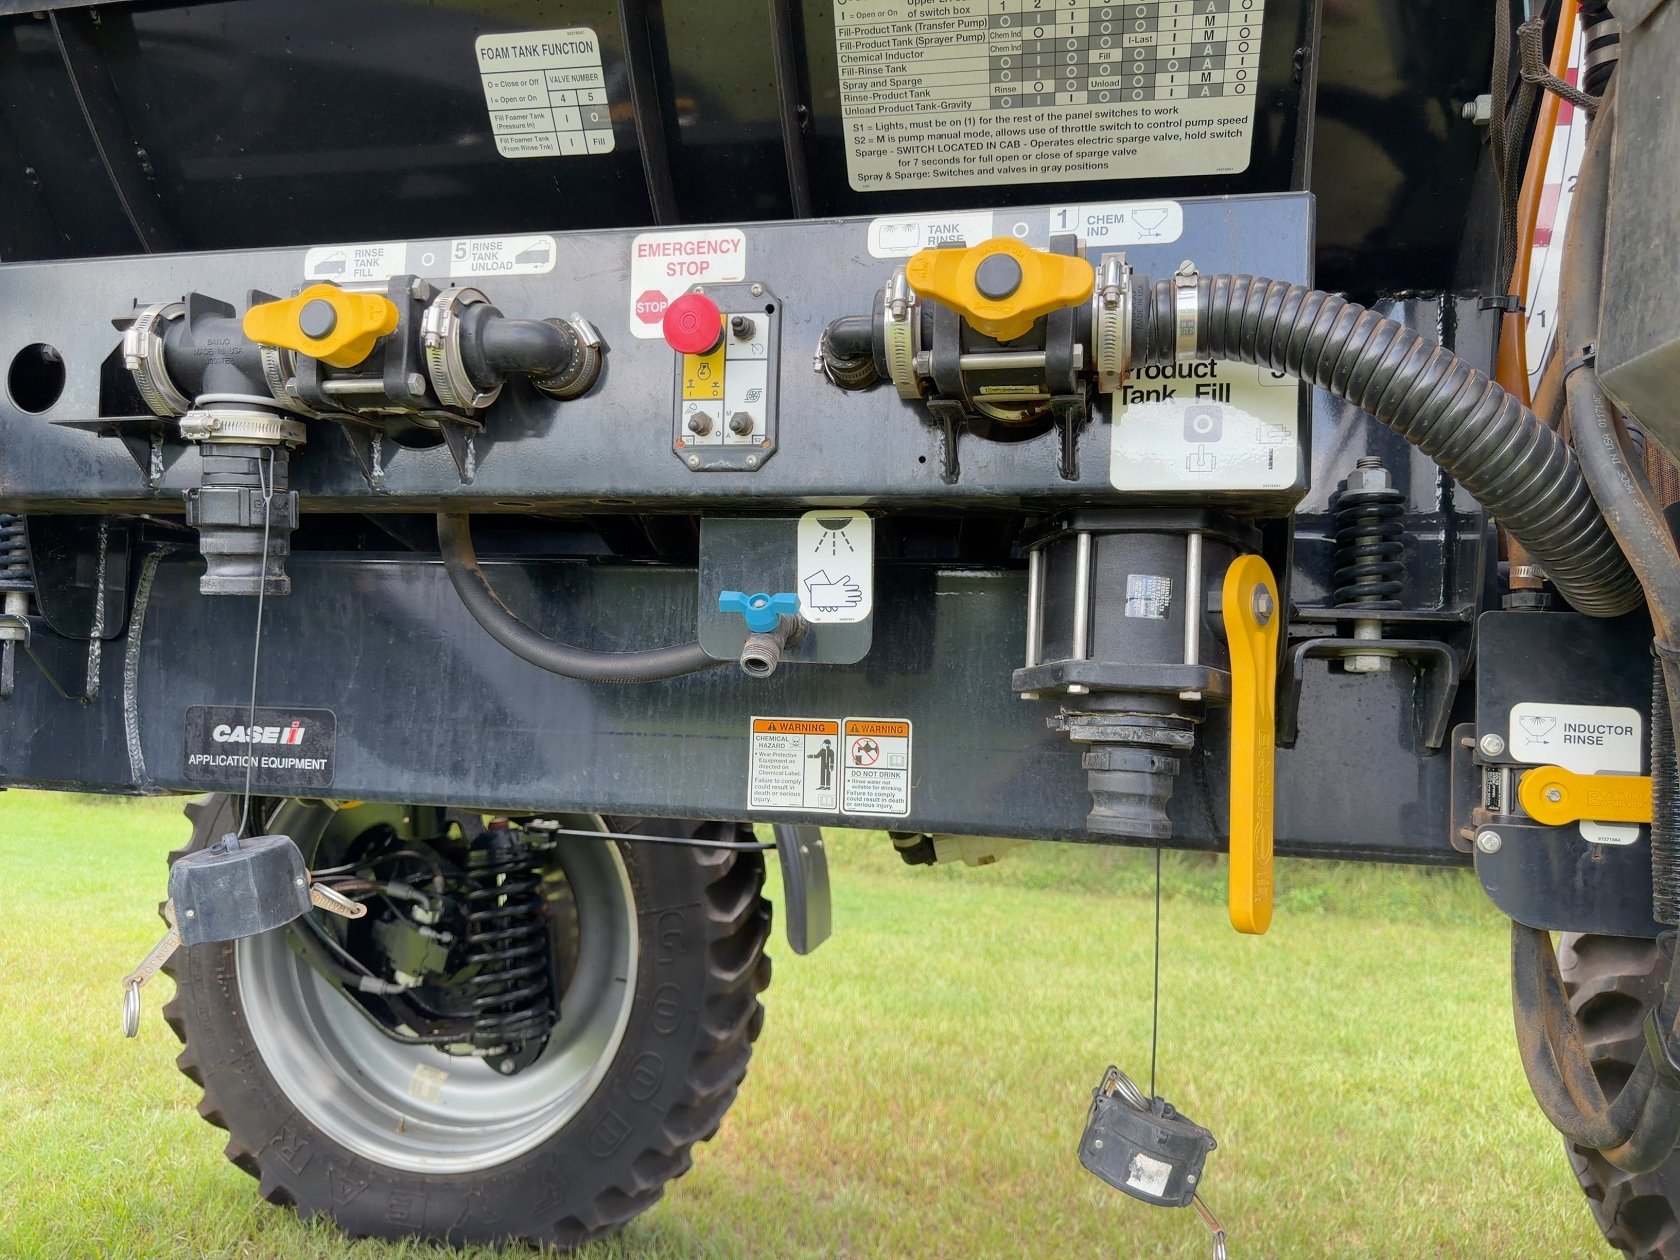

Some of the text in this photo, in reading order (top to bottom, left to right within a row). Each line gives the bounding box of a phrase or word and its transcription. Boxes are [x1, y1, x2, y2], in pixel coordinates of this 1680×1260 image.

[908, 9, 916, 18] of
[920, 8, 950, 18] switch
[839, 18, 987, 36] Fill-Product Tank (Transfer Pump)
[840, 32, 985, 50] Fill-Product Tank (Sprayer Pump)
[481, 41, 593, 60] FOAM TANK FUNCTION
[841, 50, 924, 63] Chemical Inductor
[842, 64, 907, 76] Fill-Rinse Tank
[549, 73, 598, 83] VALVE NUMBER
[843, 81, 868, 91] Spray
[889, 78, 922, 88] Sparge
[1091, 80, 1120, 88] Unload
[560, 94, 566, 102] 4
[588, 93, 593, 101] 5
[844, 90, 930, 102] Rinse-Product Tank
[844, 101, 972, 115] Unload Product Tank-Gravity
[853, 124, 864, 132] S1
[876, 122, 907, 132] Lights,
[909, 120, 932, 128] must
[964, 117, 976, 127] (1)
[1014, 114, 1031, 122] rest
[1035, 113, 1044, 121] of
[1066, 110, 1092, 121] panel
[1095, 109, 1138, 118] switches
[1154, 106, 1179, 115] work
[898, 134, 924, 143] pump
[928, 131, 960, 140] manual
[964, 130, 992, 138] mode,
[996, 128, 1026, 137] allows
[1061, 124, 1096, 133] throttle
[1100, 122, 1131, 131] switch
[1147, 119, 1182, 128] control
[1185, 119, 1213, 128] pump
[1217, 116, 1248, 126] speed
[856, 149, 887, 158] Sparge
[897, 145, 934, 154] SWITCH
[937, 142, 984, 152] LOCATED
[1000, 141, 1020, 149] CAB
[1030, 138, 1074, 148] Operates
[1077, 136, 1113, 145] electric
[1116, 135, 1150, 144] sparge
[1154, 133, 1181, 141] valve,
[1184, 131, 1206, 139] hold
[1210, 129, 1242, 139] switch
[922, 157, 960, 166] seconds
[996, 155, 1019, 163] open
[1076, 149, 1109, 159] sparge
[895, 171, 930, 180] Sparge:
[933, 168, 974, 177] Switches
[977, 167, 994, 175] and
[1041, 164, 1062, 174] gray
[1065, 162, 1109, 172] positions
[1568, 176, 1578, 193] 2
[1057, 210, 1068, 228] 1
[1087, 214, 1124, 225] CHEM
[928, 224, 960, 234] TANK
[1087, 226, 1109, 236] IND
[472, 242, 502, 251] RINSE
[928, 235, 964, 246] RINSE
[354, 249, 384, 258] RINSE
[455, 242, 467, 259] 5
[638, 239, 740, 258] EMERGENCY
[354, 259, 379, 267] TANK
[472, 252, 498, 261] TANK
[354, 269, 373, 277] FILL
[471, 262, 513, 271] UNLOAD
[667, 261, 709, 276] STOP
[637, 302, 666, 313] STOP
[1537, 310, 1546, 328] 1
[1125, 358, 1217, 380] roduct
[1123, 383, 1231, 405] Tank Fill
[213, 724, 280, 743] CASE
[780, 723, 825, 732] WARNING
[862, 725, 903, 734] WARNING
[1564, 723, 1633, 736] INDUCTOR
[1564, 736, 1603, 746] RINSE
[189, 755, 327, 770] APPLICATION EQUIPMENT
